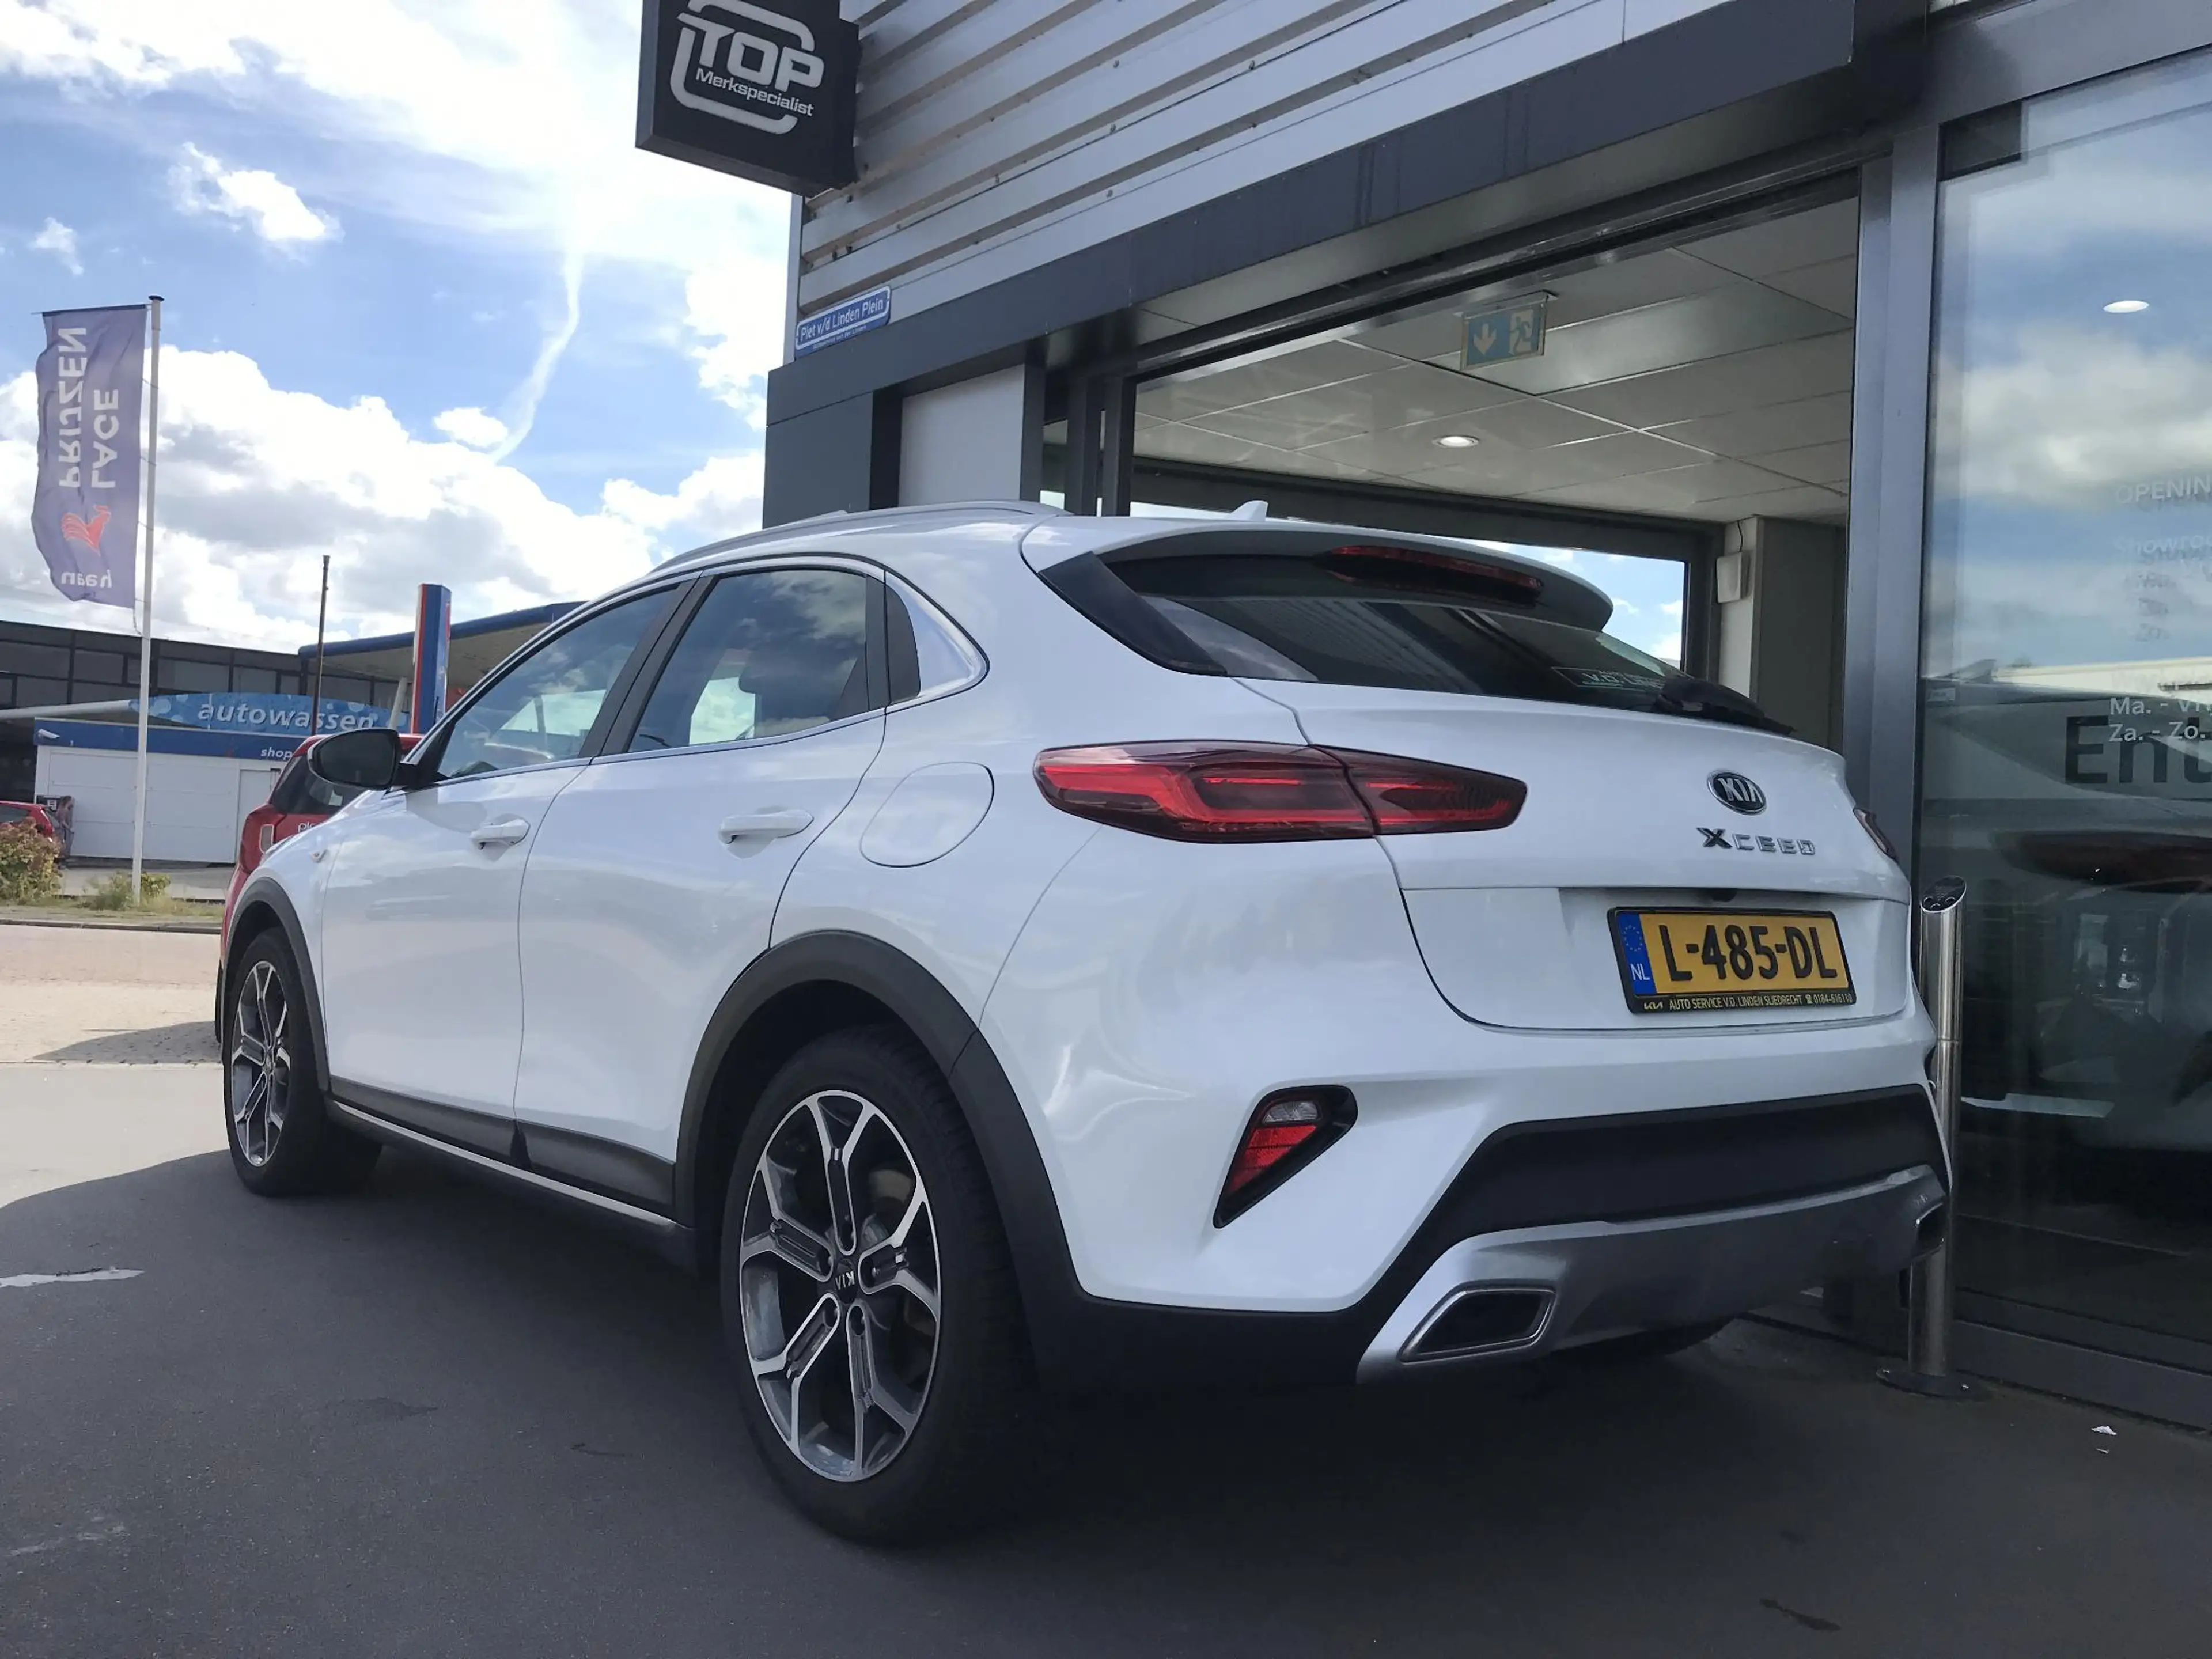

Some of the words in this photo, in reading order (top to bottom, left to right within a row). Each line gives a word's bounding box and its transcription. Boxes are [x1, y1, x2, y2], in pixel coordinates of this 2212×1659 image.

[677, 12, 824, 92] TOP
[696, 68, 814, 116] Merkspecialist
[800, 324, 815, 342] Piet
[817, 317, 831, 335] v/d
[832, 308, 859, 328] Linden
[862, 298, 883, 317] Plein
[198, 702, 376, 730] autowassen
[2110, 697, 2151, 715] Ma.
[2109, 724, 2143, 742] Za.
[2168, 721, 2205, 740] Zo.
[261, 747, 293, 759] shop
[1717, 777, 1764, 804] KIA
[1696, 827, 1815, 855] XCEED
[1659, 925, 1838, 982] L-485-DL
[1630, 963, 1650, 980] NL
[1669, 999, 1691, 1010] AUTO
[1691, 997, 1722, 1009] SERVICE
[1737, 995, 1763, 1007] LINDEN
[1764, 994, 1802, 1006] SLIEDRECHT
